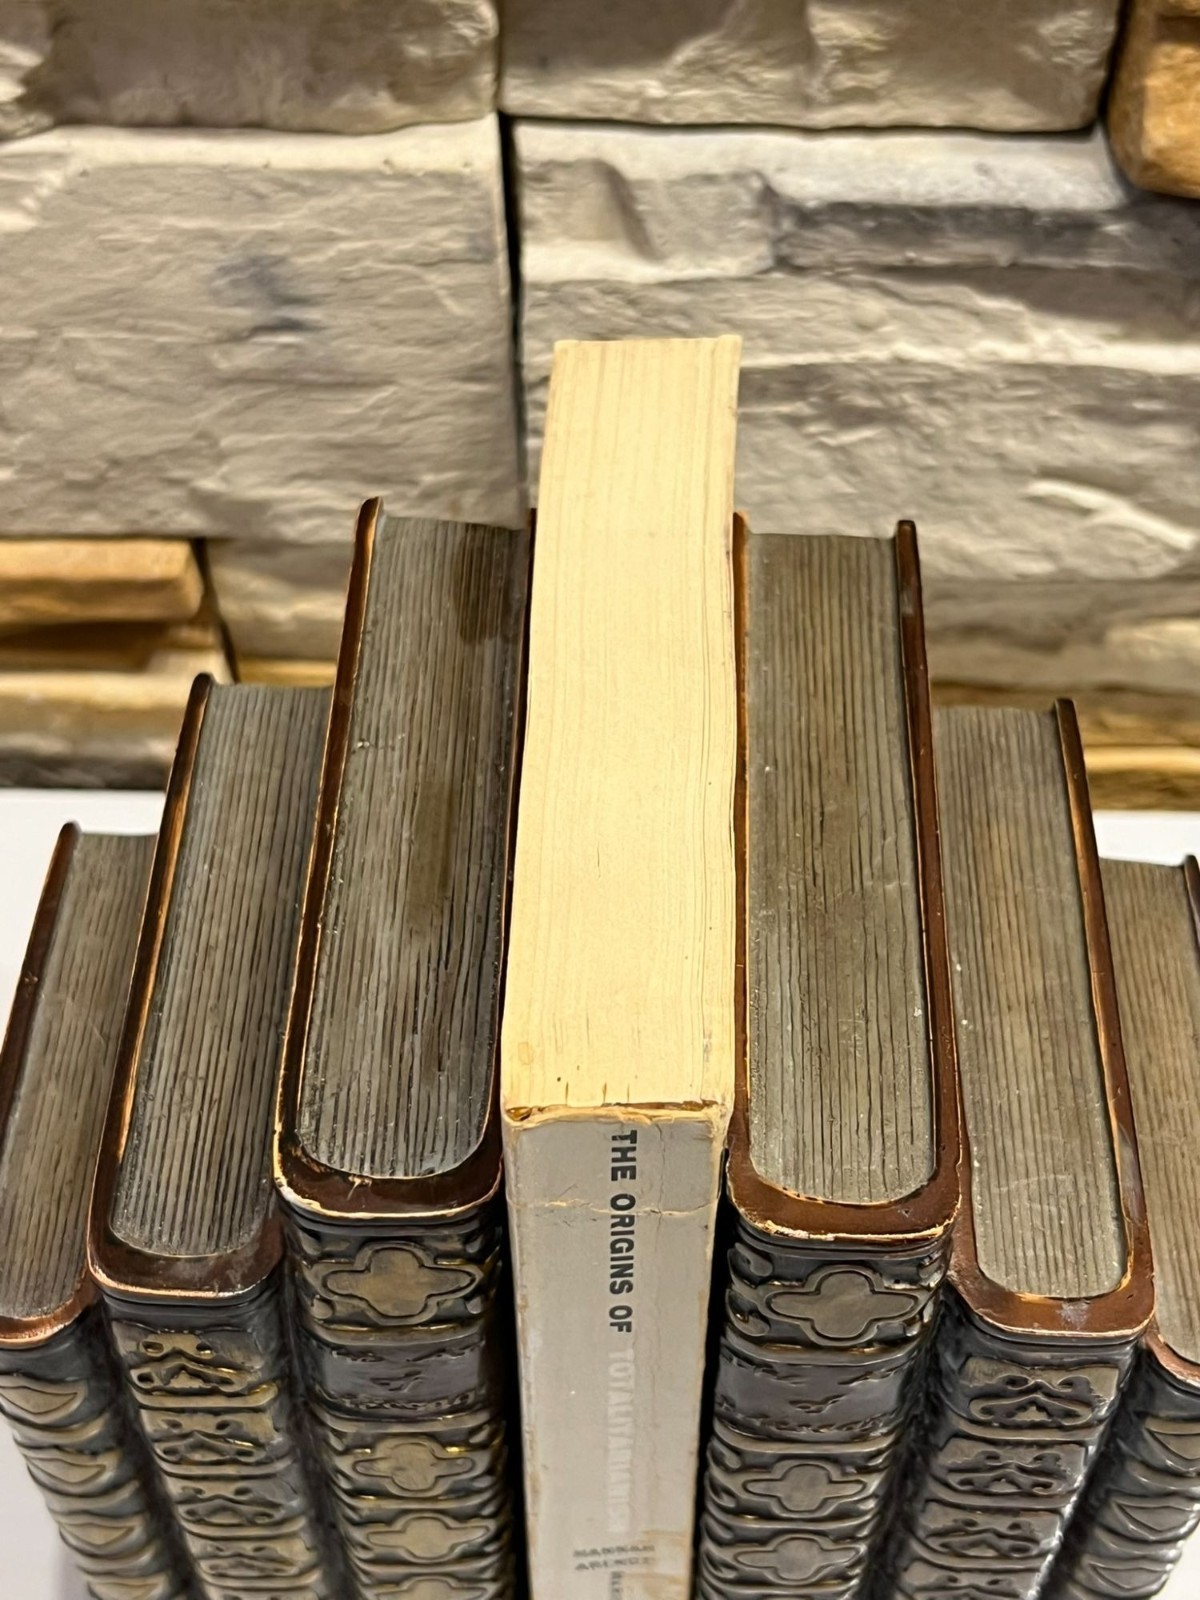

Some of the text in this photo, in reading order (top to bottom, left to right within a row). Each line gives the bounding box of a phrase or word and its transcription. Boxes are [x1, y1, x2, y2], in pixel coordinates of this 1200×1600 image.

[611, 1129, 638, 1182] THE
[609, 1193, 637, 1296] ORIGINS
[608, 1305, 634, 1334] OF
